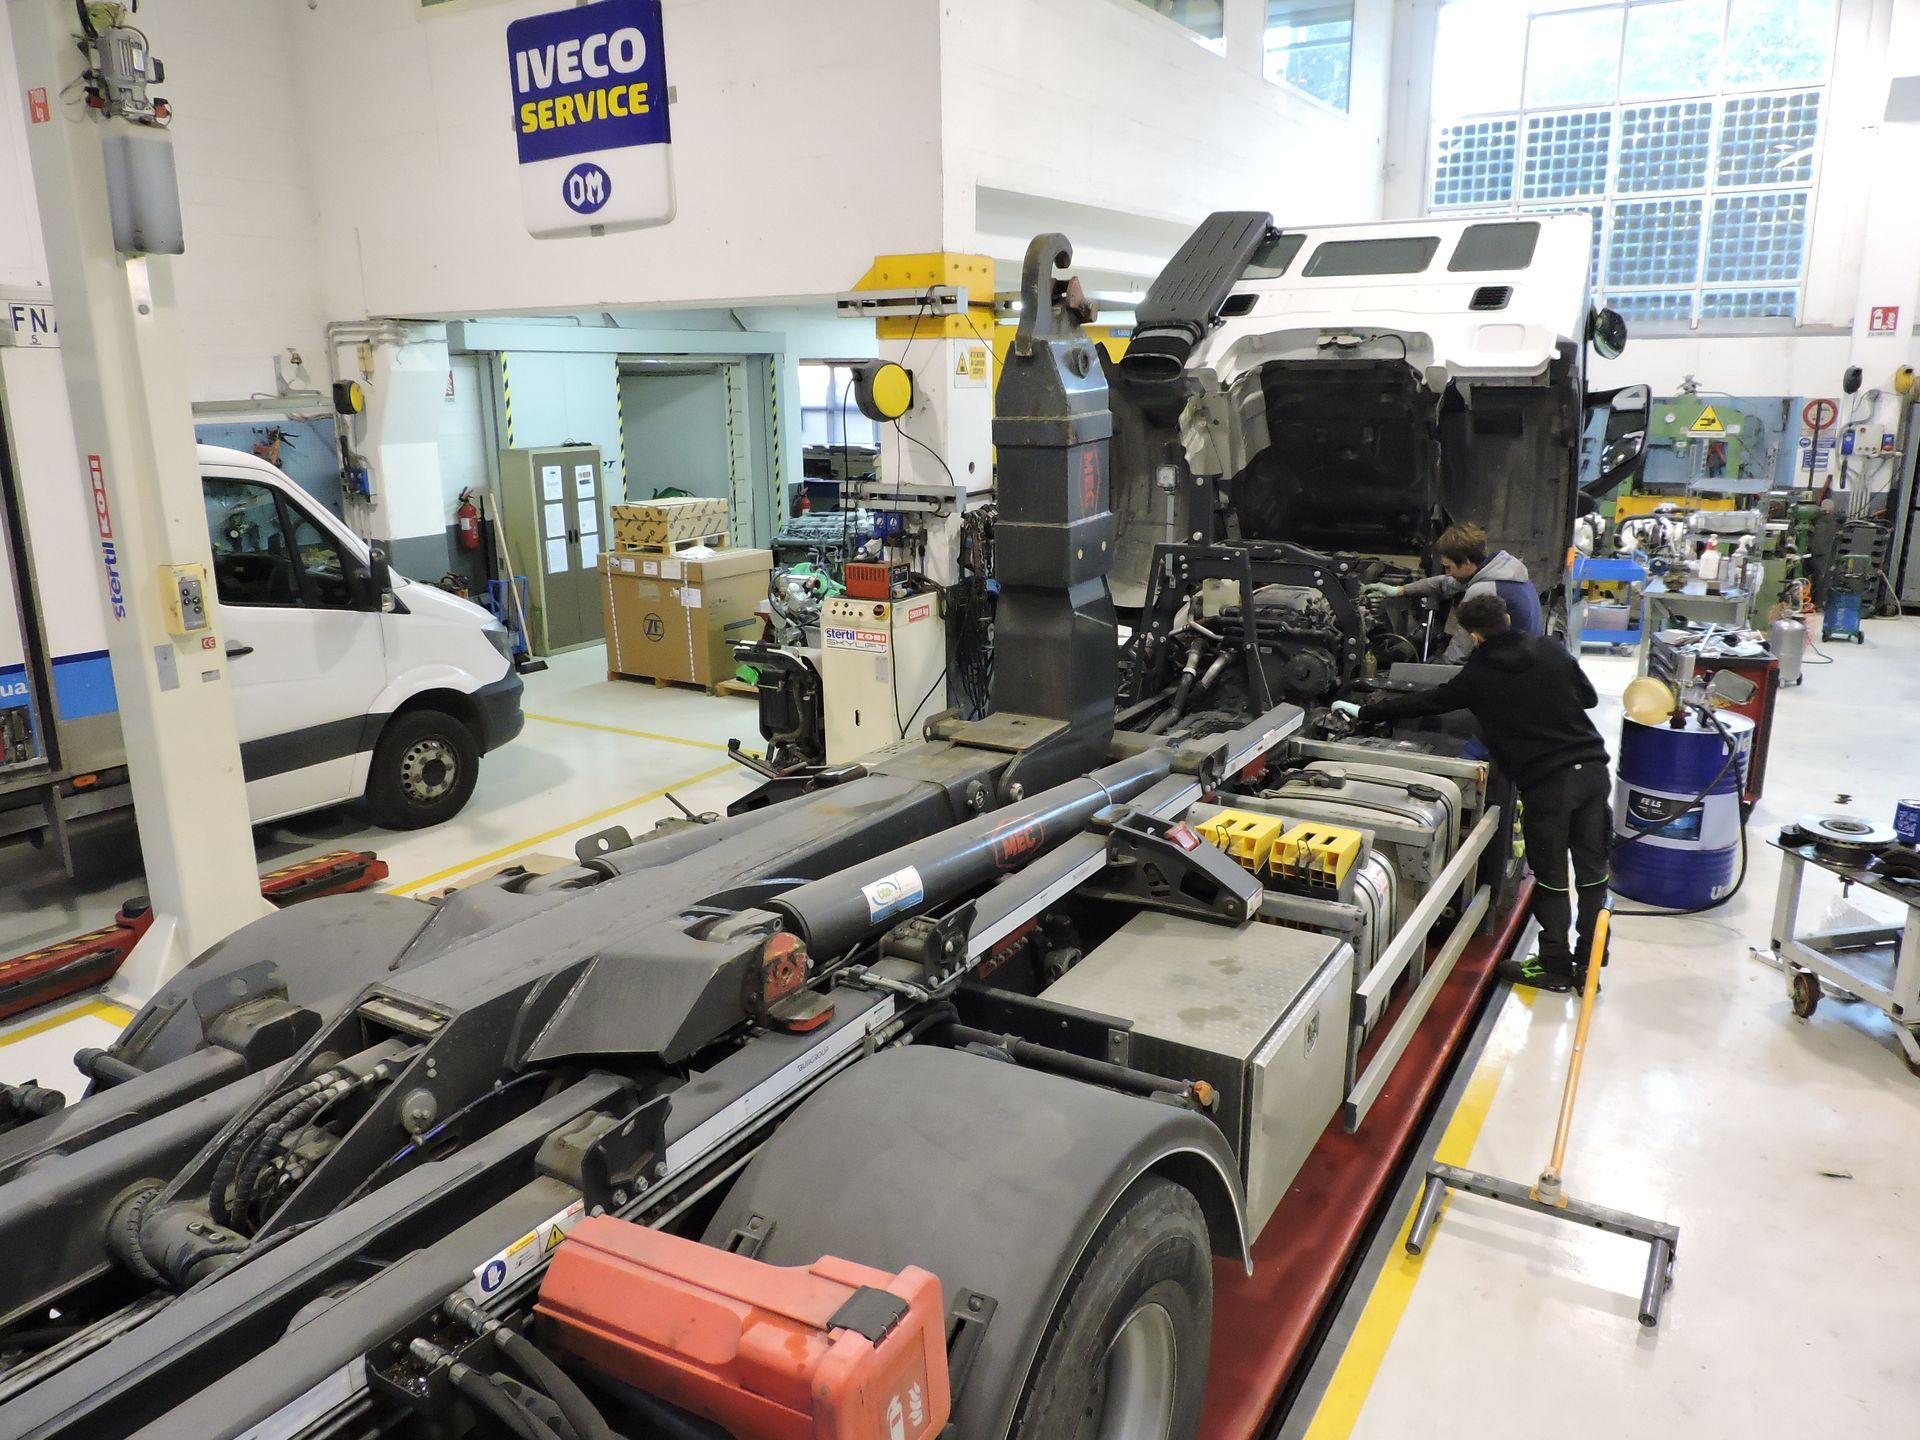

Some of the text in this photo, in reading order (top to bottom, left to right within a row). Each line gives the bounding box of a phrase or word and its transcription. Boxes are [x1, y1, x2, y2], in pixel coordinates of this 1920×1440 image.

[516, 27, 646, 93] IVECO
[520, 82, 650, 134] SERVICE
[569, 170, 604, 207] OM
[11, 306, 58, 333] FN
[89, 459, 126, 621] stertil KONI
[646, 619, 663, 636] ZF
[825, 628, 886, 642] stertil KONI
[826, 639, 887, 651] SKYLIFT
[1002, 825, 1037, 860] MEC
